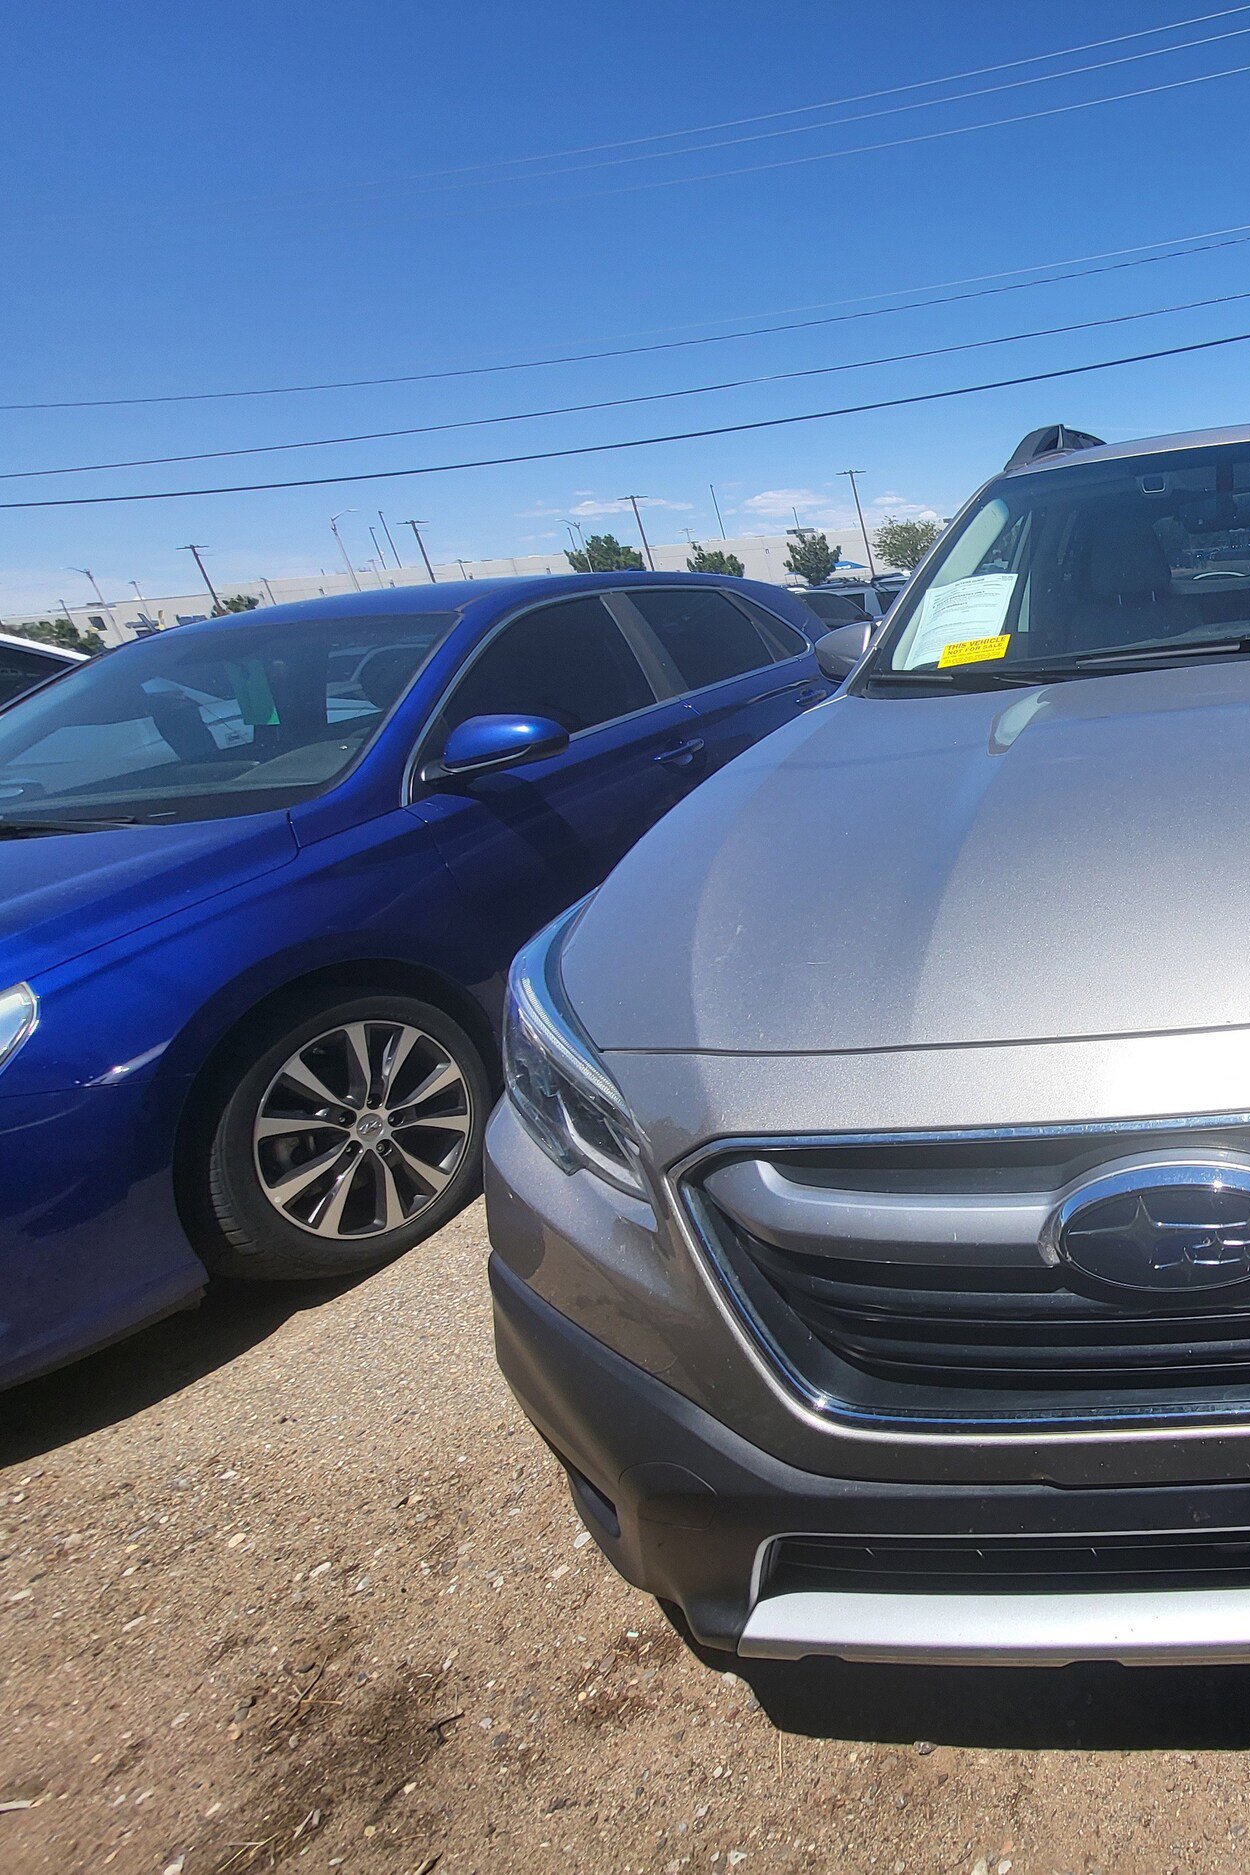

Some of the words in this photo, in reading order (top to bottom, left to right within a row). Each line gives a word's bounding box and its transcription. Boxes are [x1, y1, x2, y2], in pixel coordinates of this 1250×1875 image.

[948, 642, 967, 651] THIS
[969, 636, 1007, 647] VEHICLE
[982, 642, 1003, 650] SALE
